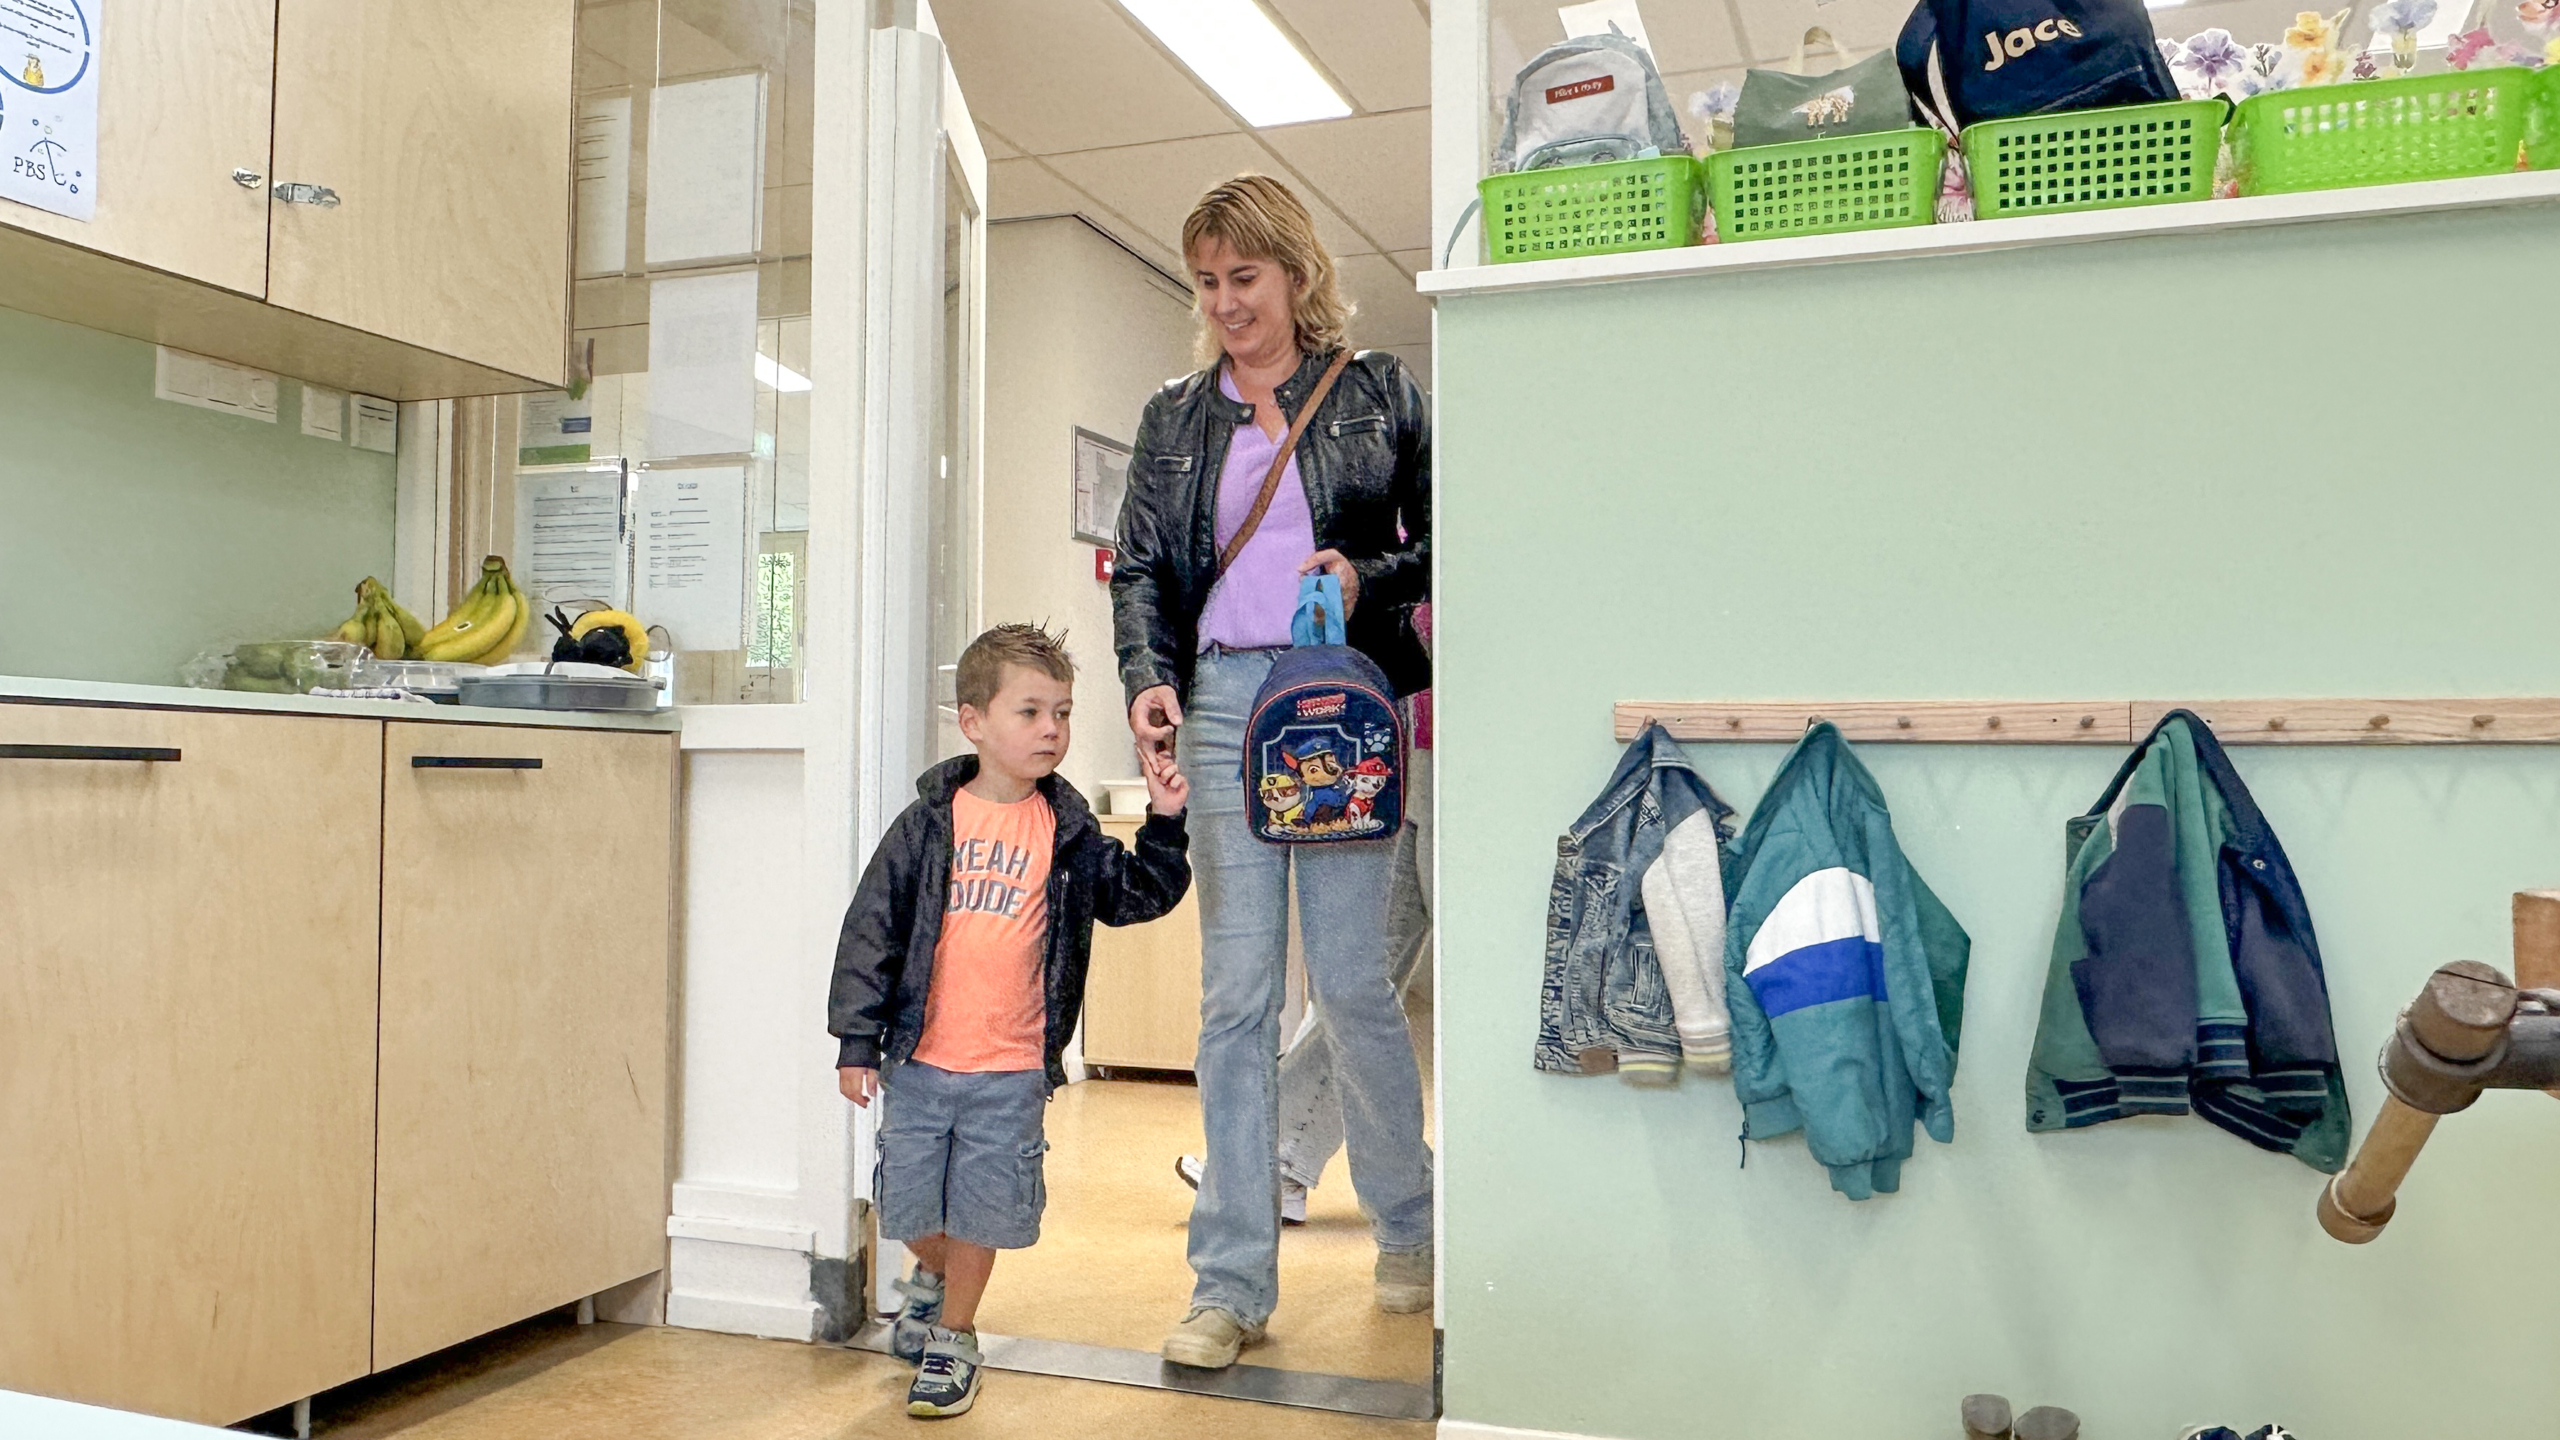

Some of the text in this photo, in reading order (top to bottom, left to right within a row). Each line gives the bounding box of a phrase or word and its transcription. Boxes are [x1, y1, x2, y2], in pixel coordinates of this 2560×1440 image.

[1984, 18, 2082, 71] Jace
[13, 156, 45, 180] PBS
[954, 838, 1031, 881] YEAH
[947, 879, 1028, 919] DUDE
